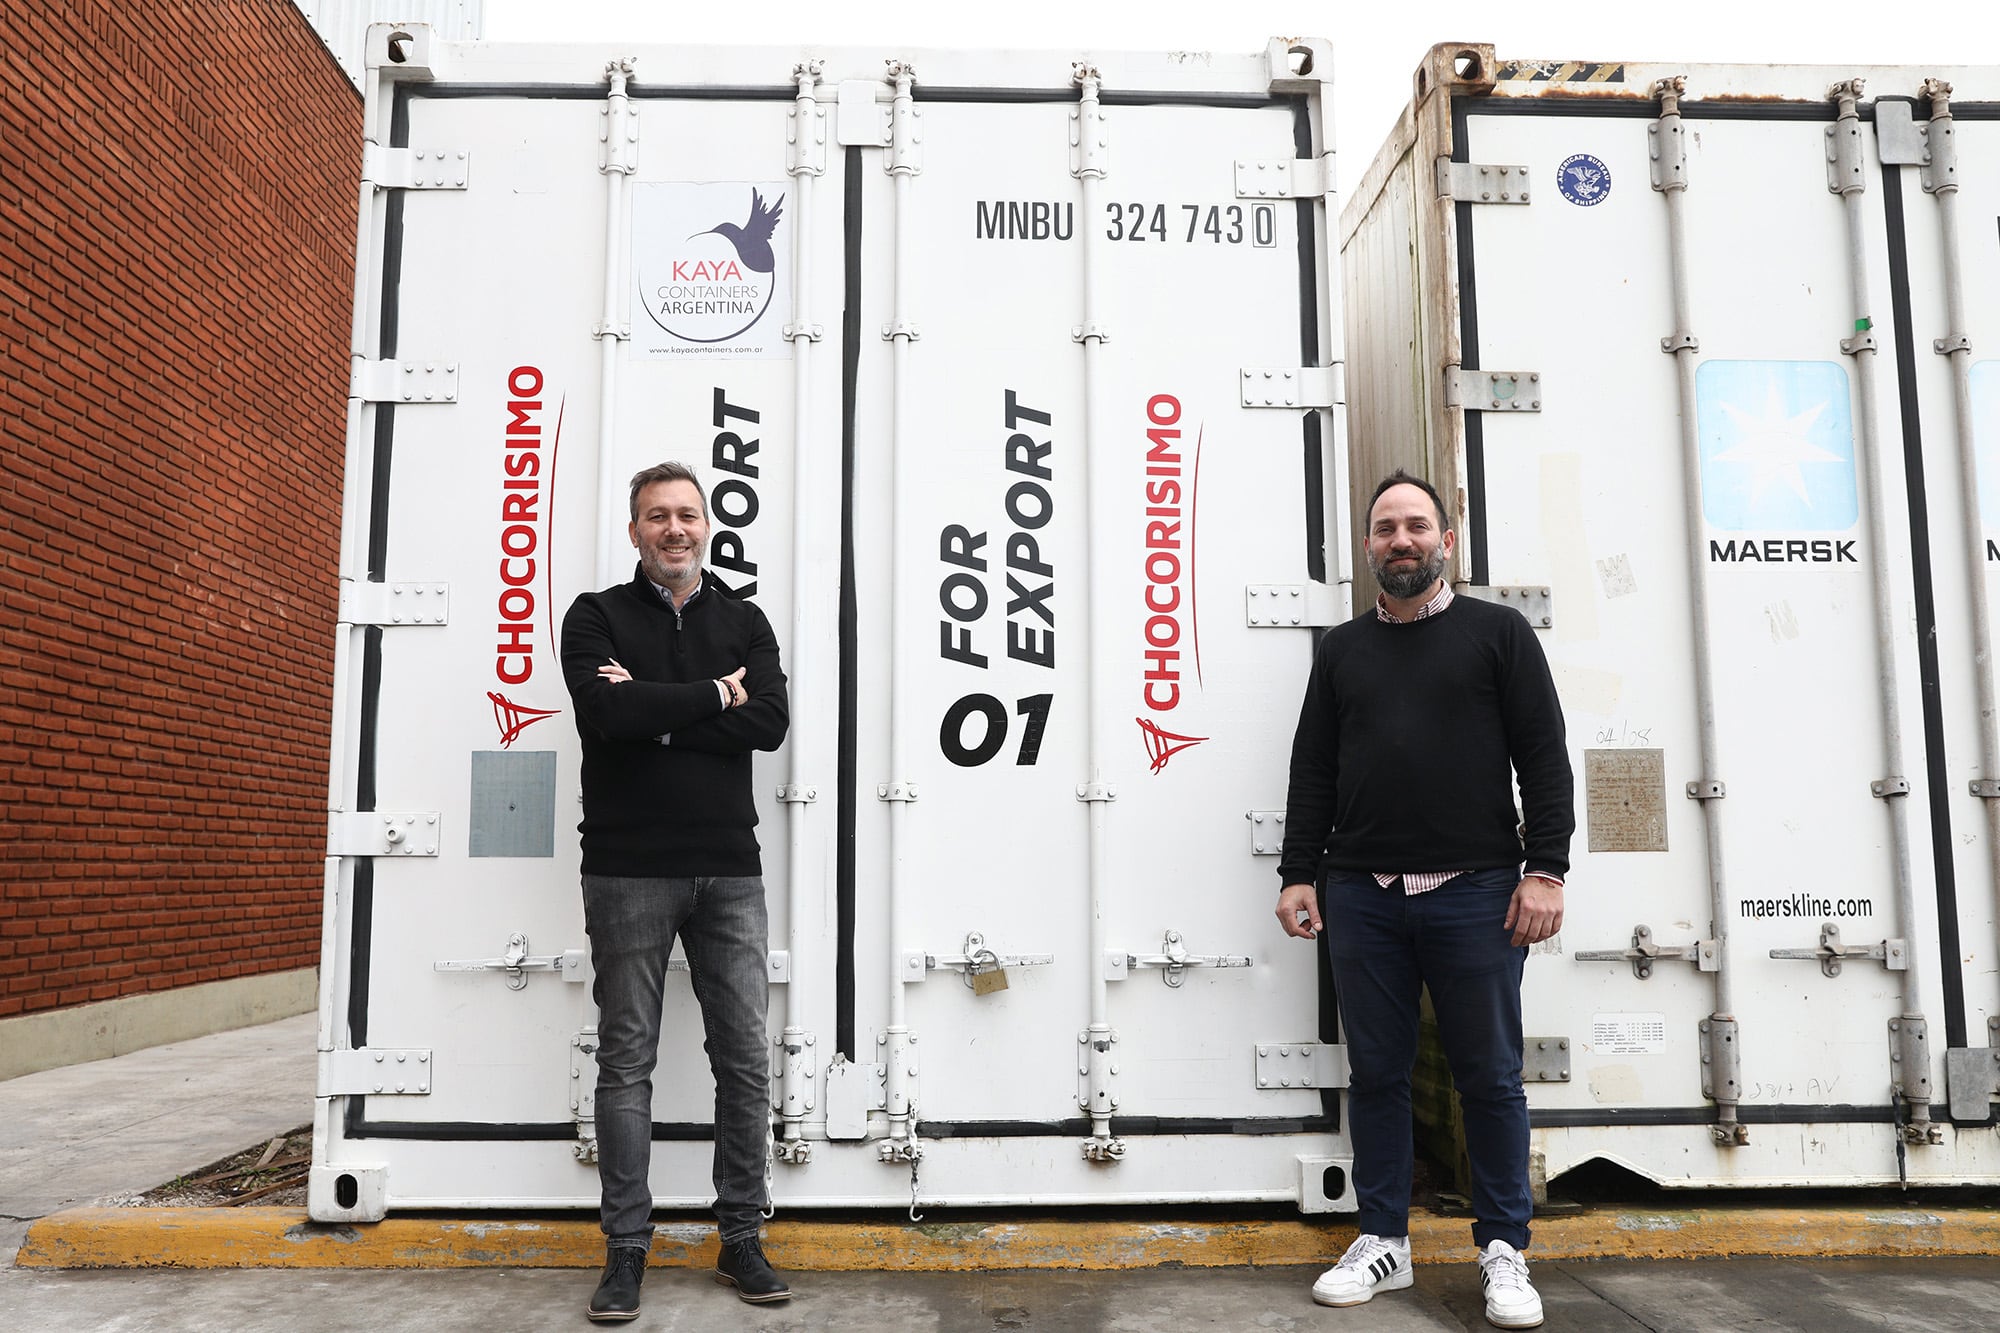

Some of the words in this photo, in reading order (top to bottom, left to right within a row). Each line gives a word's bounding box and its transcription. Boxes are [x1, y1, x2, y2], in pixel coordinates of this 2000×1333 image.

[1558, 154, 1585, 184] AMERICAN
[1587, 156, 1610, 181] BUREAU
[1564, 192, 1575, 201] OF
[1574, 190, 1608, 206] SHIPPING
[976, 201, 1073, 240] MNBU
[1106, 202, 1167, 242] 324
[1181, 204, 1244, 244] 743
[1255, 206, 1273, 245] 0
[673, 260, 742, 281] KAYA
[657, 286, 759, 299] CONTAINERS
[660, 301, 755, 314] ARGENTINA
[649, 345, 763, 355] www.kayacontainers.com.ar
[710, 386, 760, 600] XPORT
[497, 366, 543, 685] CHOCORISIMO
[1005, 389, 1055, 669] EXPORT
[1144, 394, 1182, 711] CHOCORISIMO
[1710, 539, 1858, 563] MAERSK
[940, 524, 989, 669] FOR
[940, 692, 1054, 767] 01
[1740, 893, 1873, 918] maerskline.com
